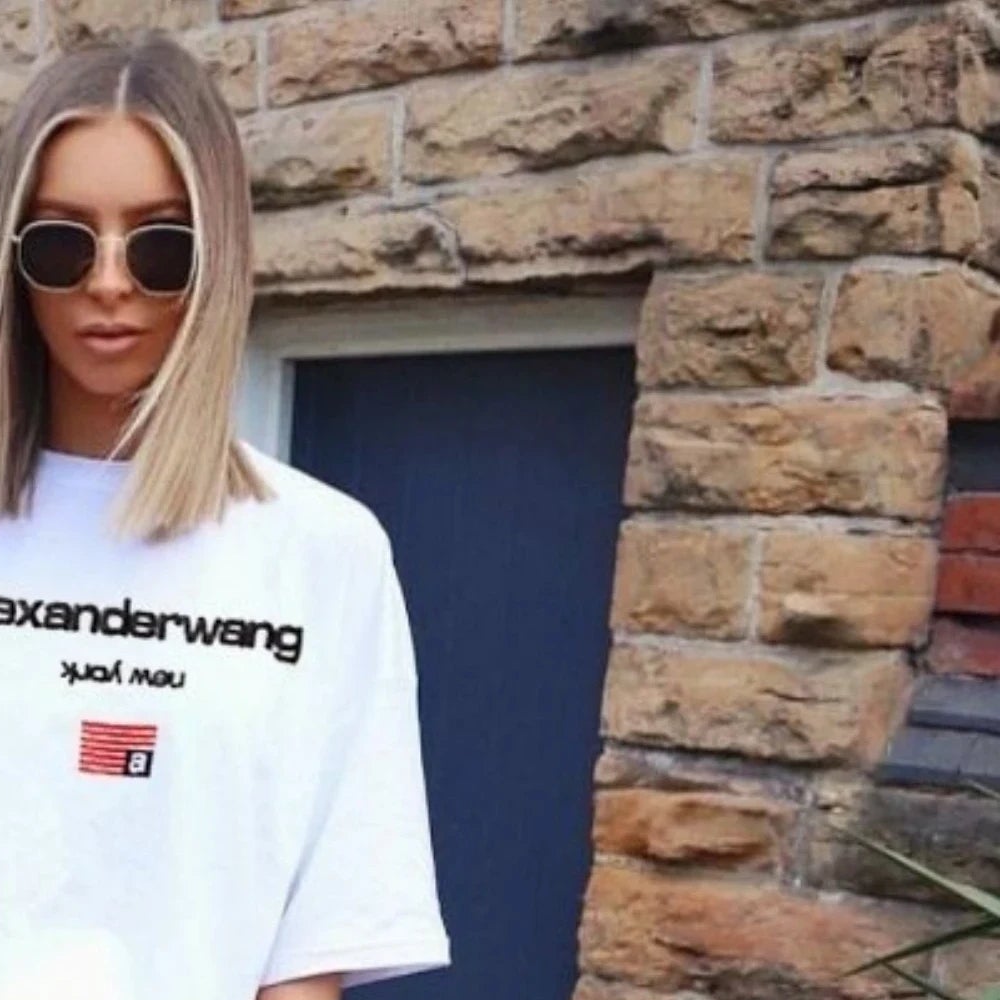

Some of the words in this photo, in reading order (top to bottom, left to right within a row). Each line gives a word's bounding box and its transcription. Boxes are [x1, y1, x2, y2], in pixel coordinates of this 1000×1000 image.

[60, 659, 123, 686] york
[128, 667, 187, 690] new
[128, 751, 147, 774] a
